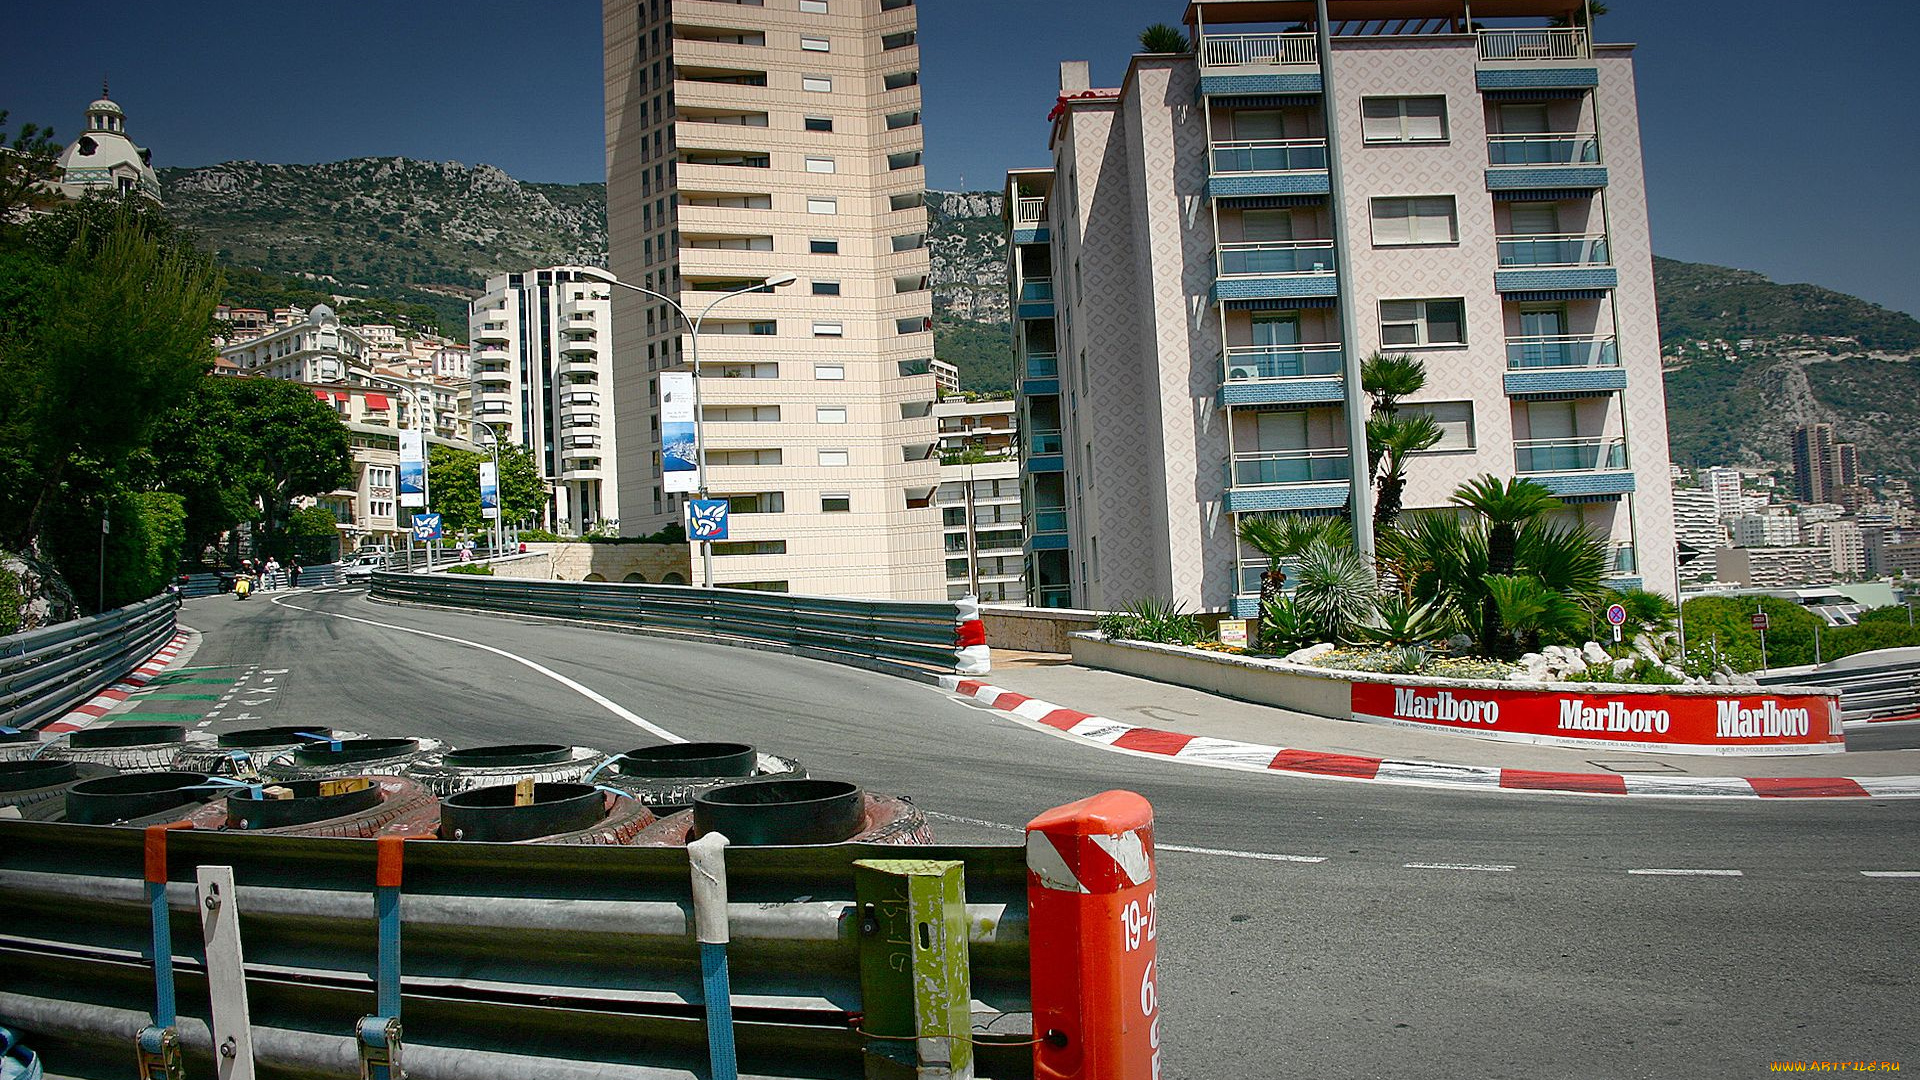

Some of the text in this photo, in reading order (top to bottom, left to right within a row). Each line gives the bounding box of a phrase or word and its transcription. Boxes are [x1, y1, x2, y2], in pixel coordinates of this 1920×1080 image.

[1393, 688, 1499, 724] Marlboro
[1557, 699, 1670, 734] Marlboro
[1716, 700, 1809, 738] Marlboro
